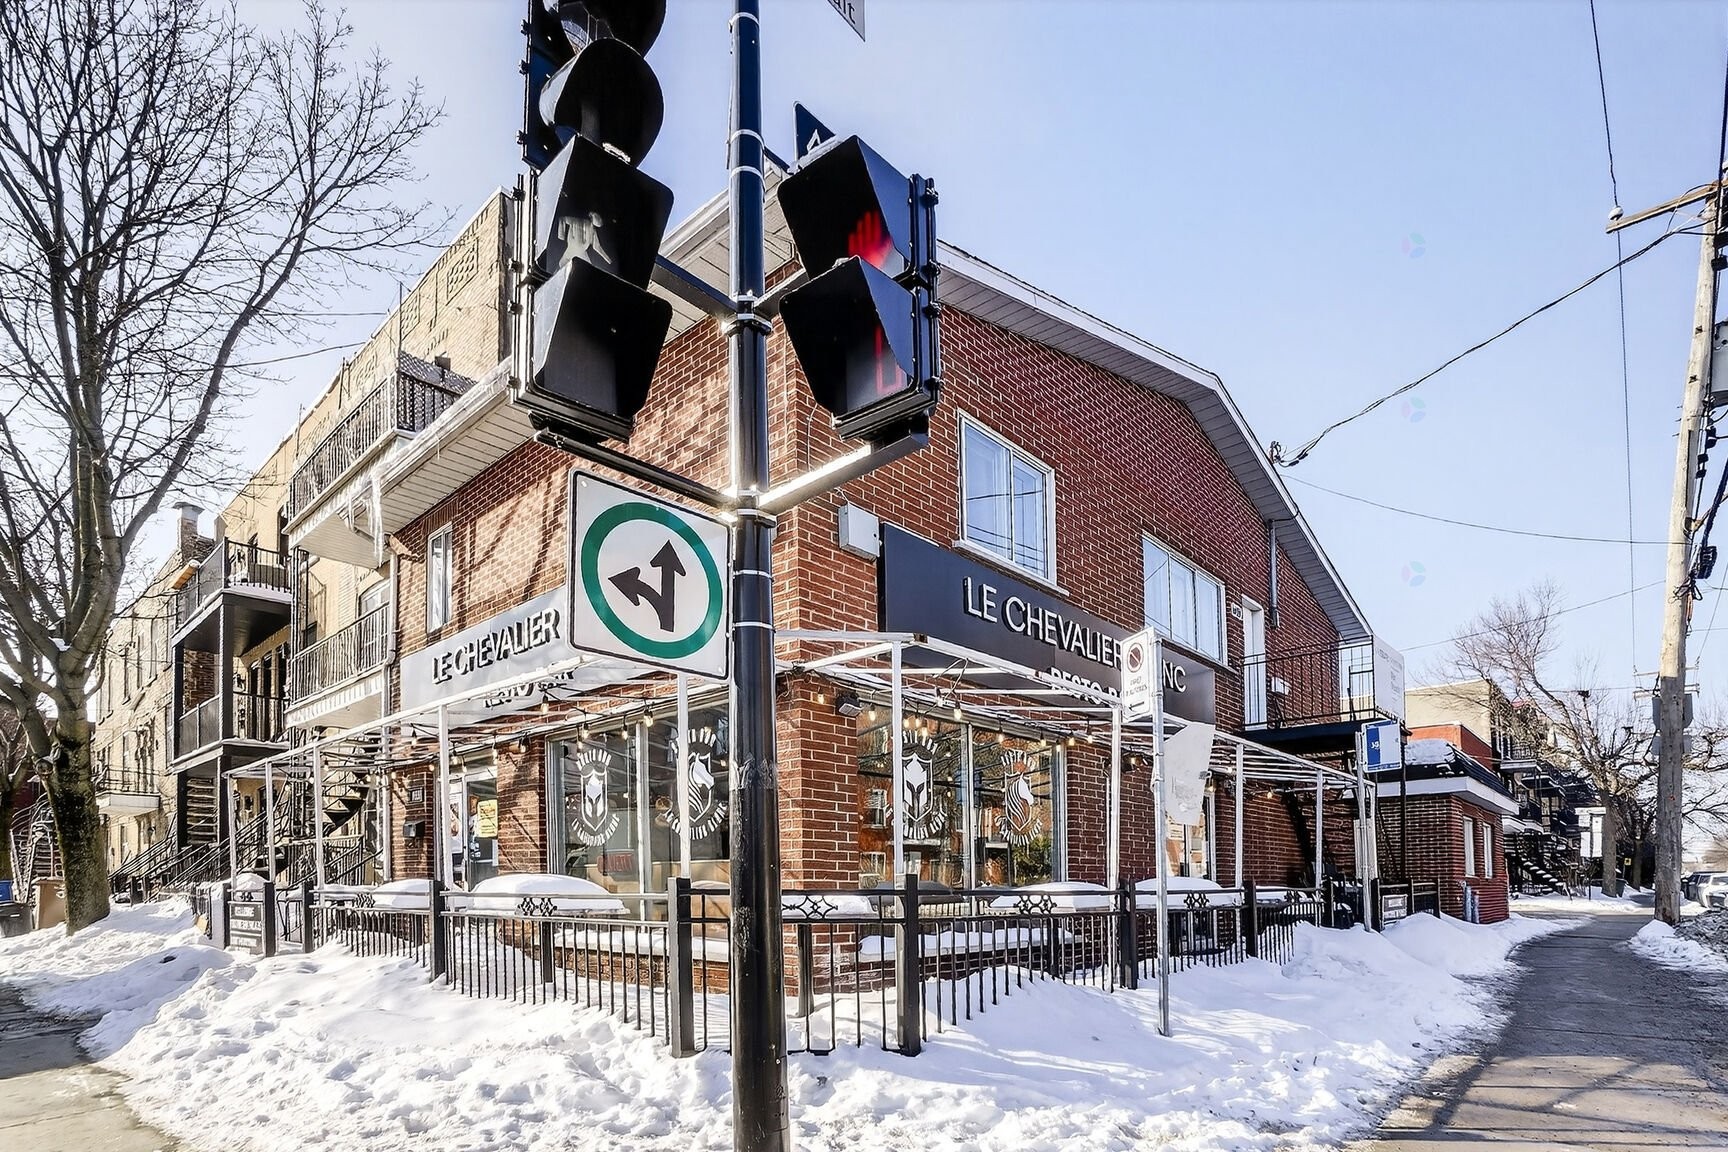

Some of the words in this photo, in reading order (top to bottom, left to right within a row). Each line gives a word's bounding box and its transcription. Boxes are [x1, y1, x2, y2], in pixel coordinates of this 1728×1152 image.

[432, 652, 453, 685] LE
[455, 607, 560, 675] CHEVALIER
[964, 576, 998, 623] LE
[1003, 596, 1122, 669] CHEVALIER
